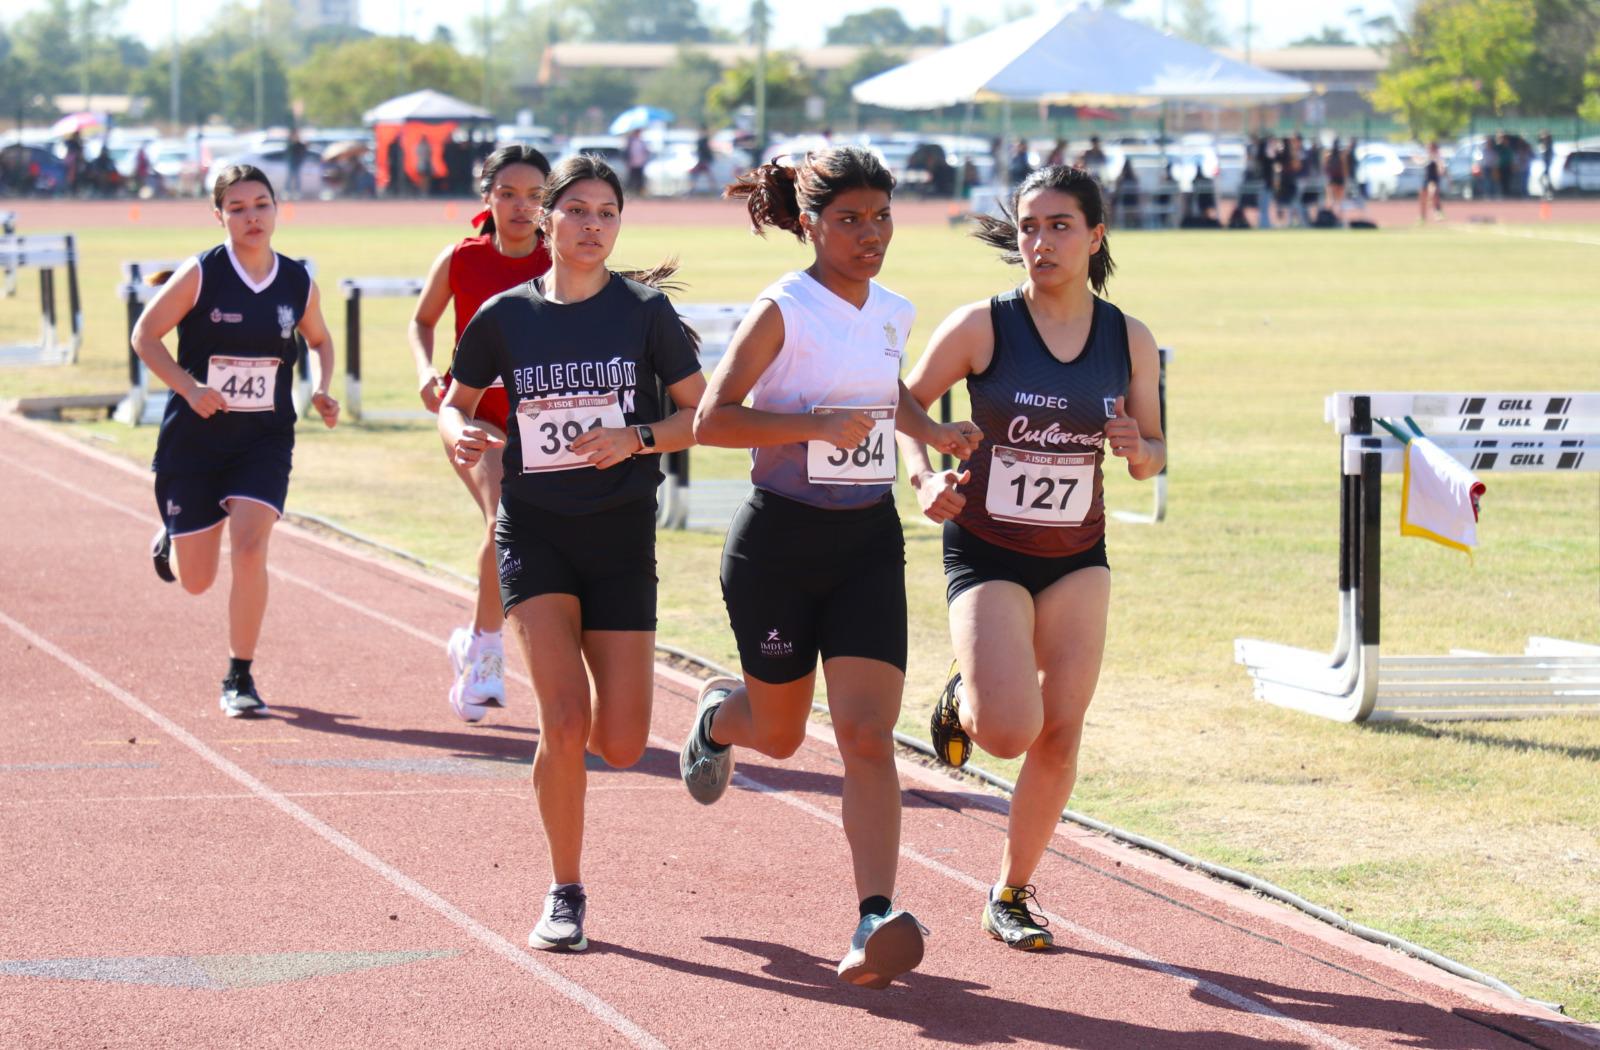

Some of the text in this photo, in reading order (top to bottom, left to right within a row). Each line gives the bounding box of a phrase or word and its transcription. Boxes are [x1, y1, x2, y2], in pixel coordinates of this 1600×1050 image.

[514, 357, 637, 394] SELECCIÓN
[221, 375, 266, 399] 443
[554, 400, 574, 408] ISDE
[1014, 391, 1068, 409] IMDEC
[1498, 399, 1532, 410] GILL
[1031, 455, 1052, 464] ISDE
[1510, 453, 1545, 465] GILL
[1010, 474, 1079, 511] 127
